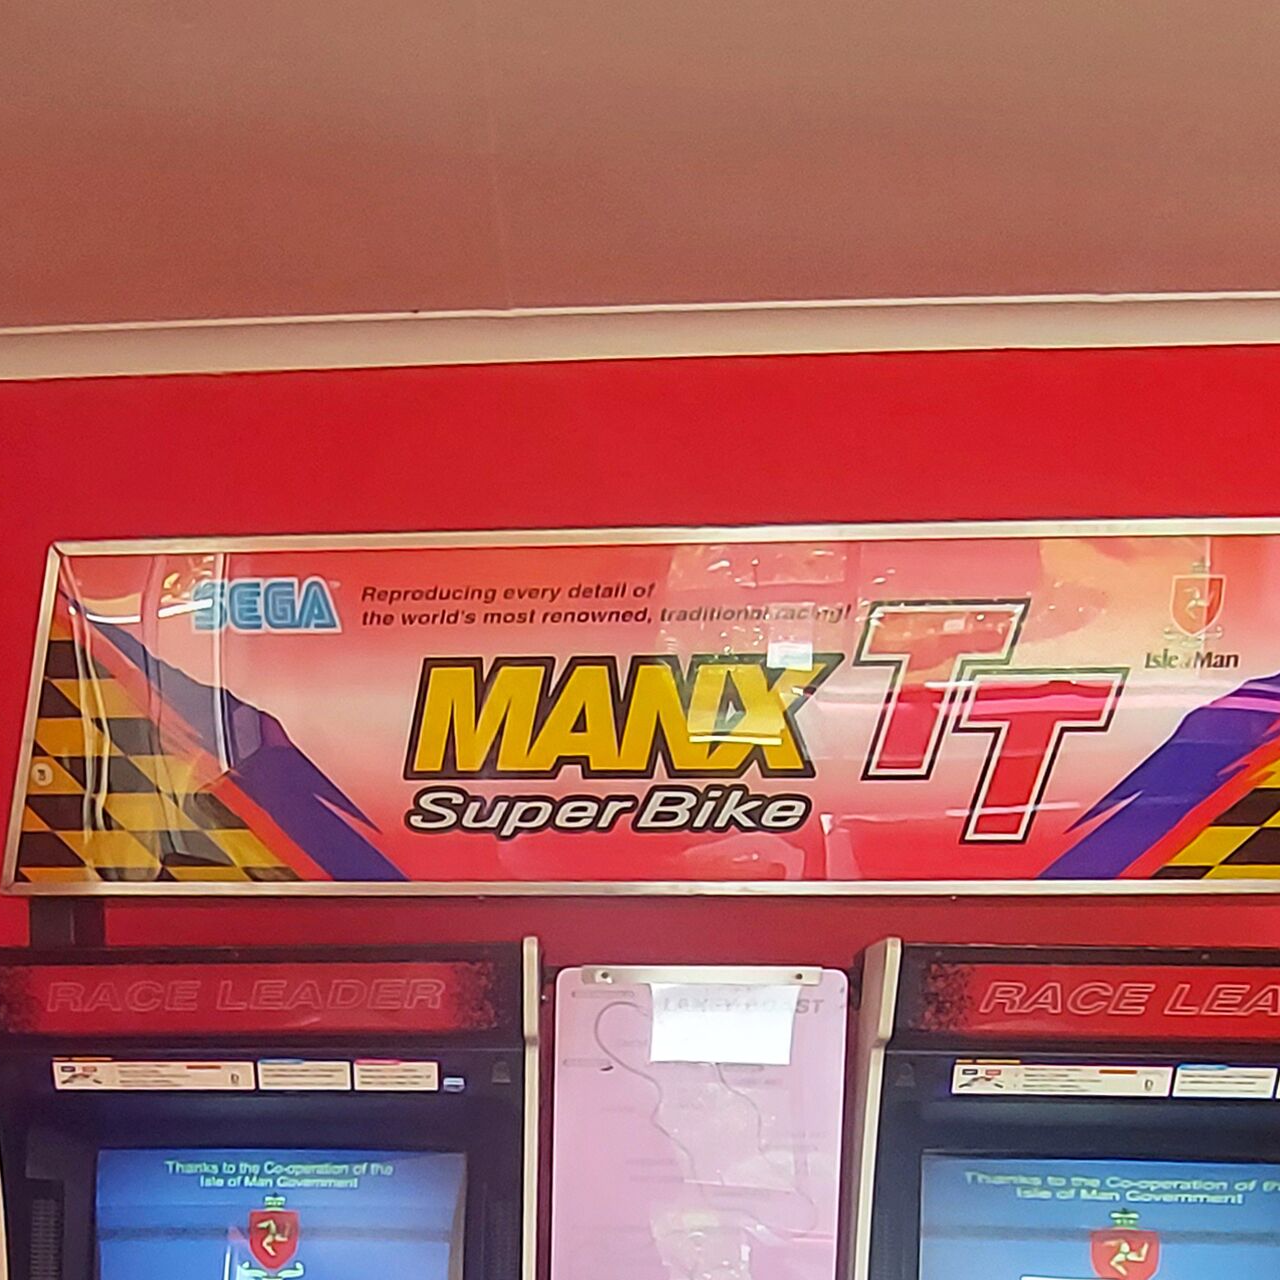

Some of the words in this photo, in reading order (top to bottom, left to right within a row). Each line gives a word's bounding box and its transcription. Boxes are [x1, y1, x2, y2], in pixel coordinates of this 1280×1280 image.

[192, 576, 342, 634] SEGA
[361, 586, 497, 607] Reproducing
[503, 587, 562, 604] every
[568, 582, 627, 601] detail
[632, 581, 656, 599] of
[362, 609, 406, 627] the
[411, 607, 478, 626] world's
[483, 609, 536, 626] most
[542, 607, 653, 626] renowned,
[660, 605, 770, 623] traditional
[1144, 648, 1180, 669] Isle
[1193, 651, 1240, 669] Man
[405, 657, 844, 779] MANX
[46, 980, 202, 1014] RACE
[217, 979, 447, 1012] LEADER
[979, 981, 1156, 1016] RACE
[165, 1161, 219, 1175] Thanks
[222, 1162, 236, 1174] to
[239, 1161, 260, 1175] the
[263, 1161, 349, 1177] Co-operation
[353, 1162, 368, 1174] of
[370, 1162, 394, 1175] the
[200, 1175, 224, 1187] Isle
[228, 1176, 242, 1188] of
[244, 1176, 274, 1188] Man
[965, 1171, 1042, 1187] Thanks
[1046, 1175, 1067, 1187] to
[1070, 1176, 1101, 1188] the
[1105, 1176, 1230, 1192] Co-operation
[1234, 1179, 1257, 1192] of
[1016, 1186, 1052, 1199] Isle
[1056, 1188, 1075, 1200] of
[1080, 1188, 1121, 1202] Man
[1125, 1190, 1244, 1205] Government
